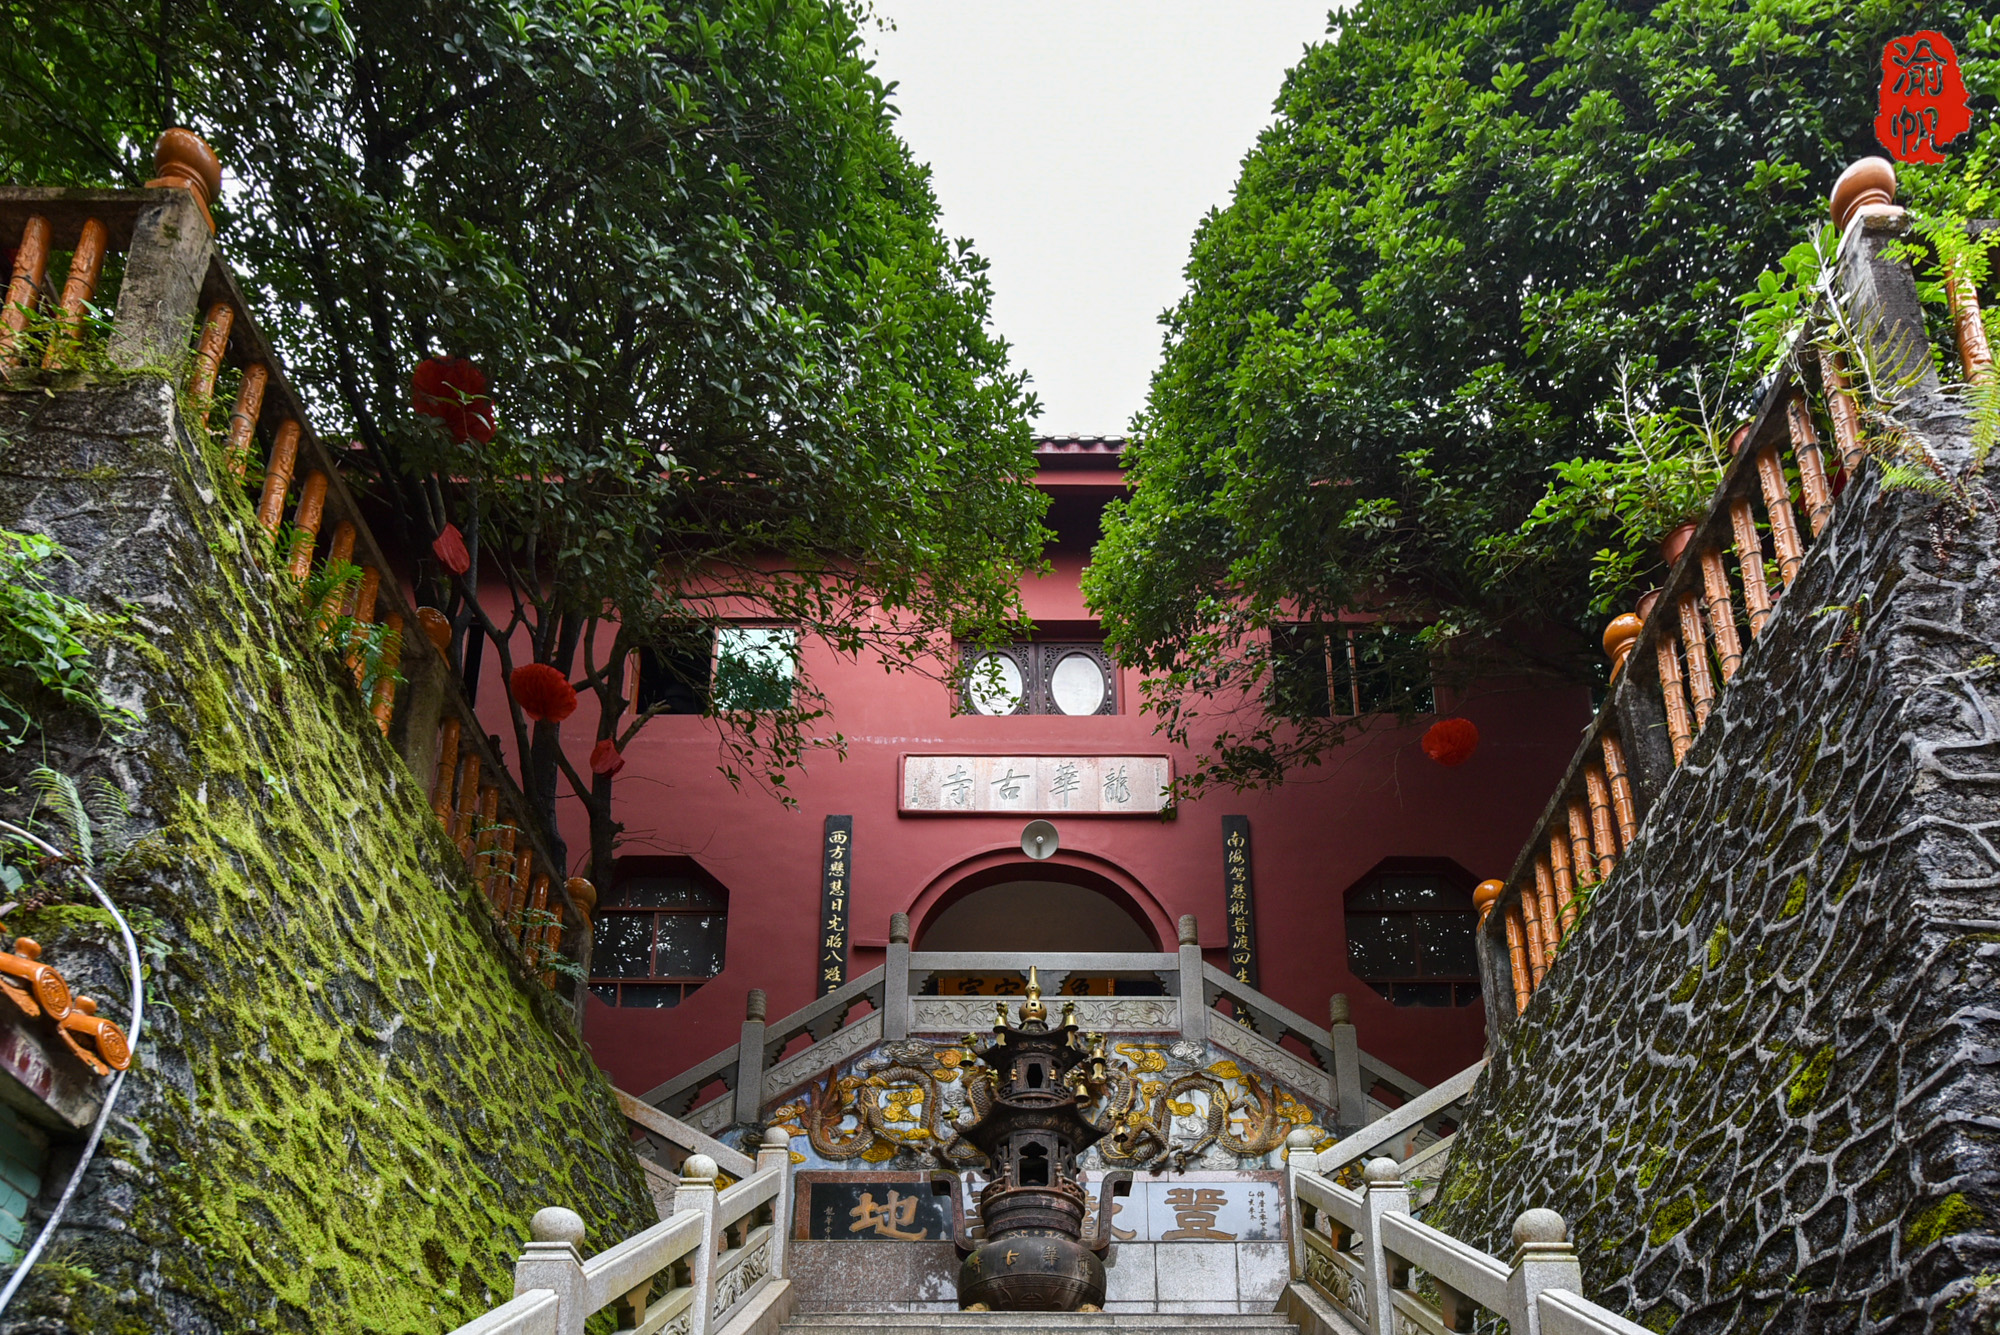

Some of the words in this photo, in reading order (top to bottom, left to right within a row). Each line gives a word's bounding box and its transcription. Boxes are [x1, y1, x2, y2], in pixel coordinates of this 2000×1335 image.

[941, 762, 1132, 807] 龍華古寺
[1227, 831, 1251, 1028] 南海駕慈航普渡四生
